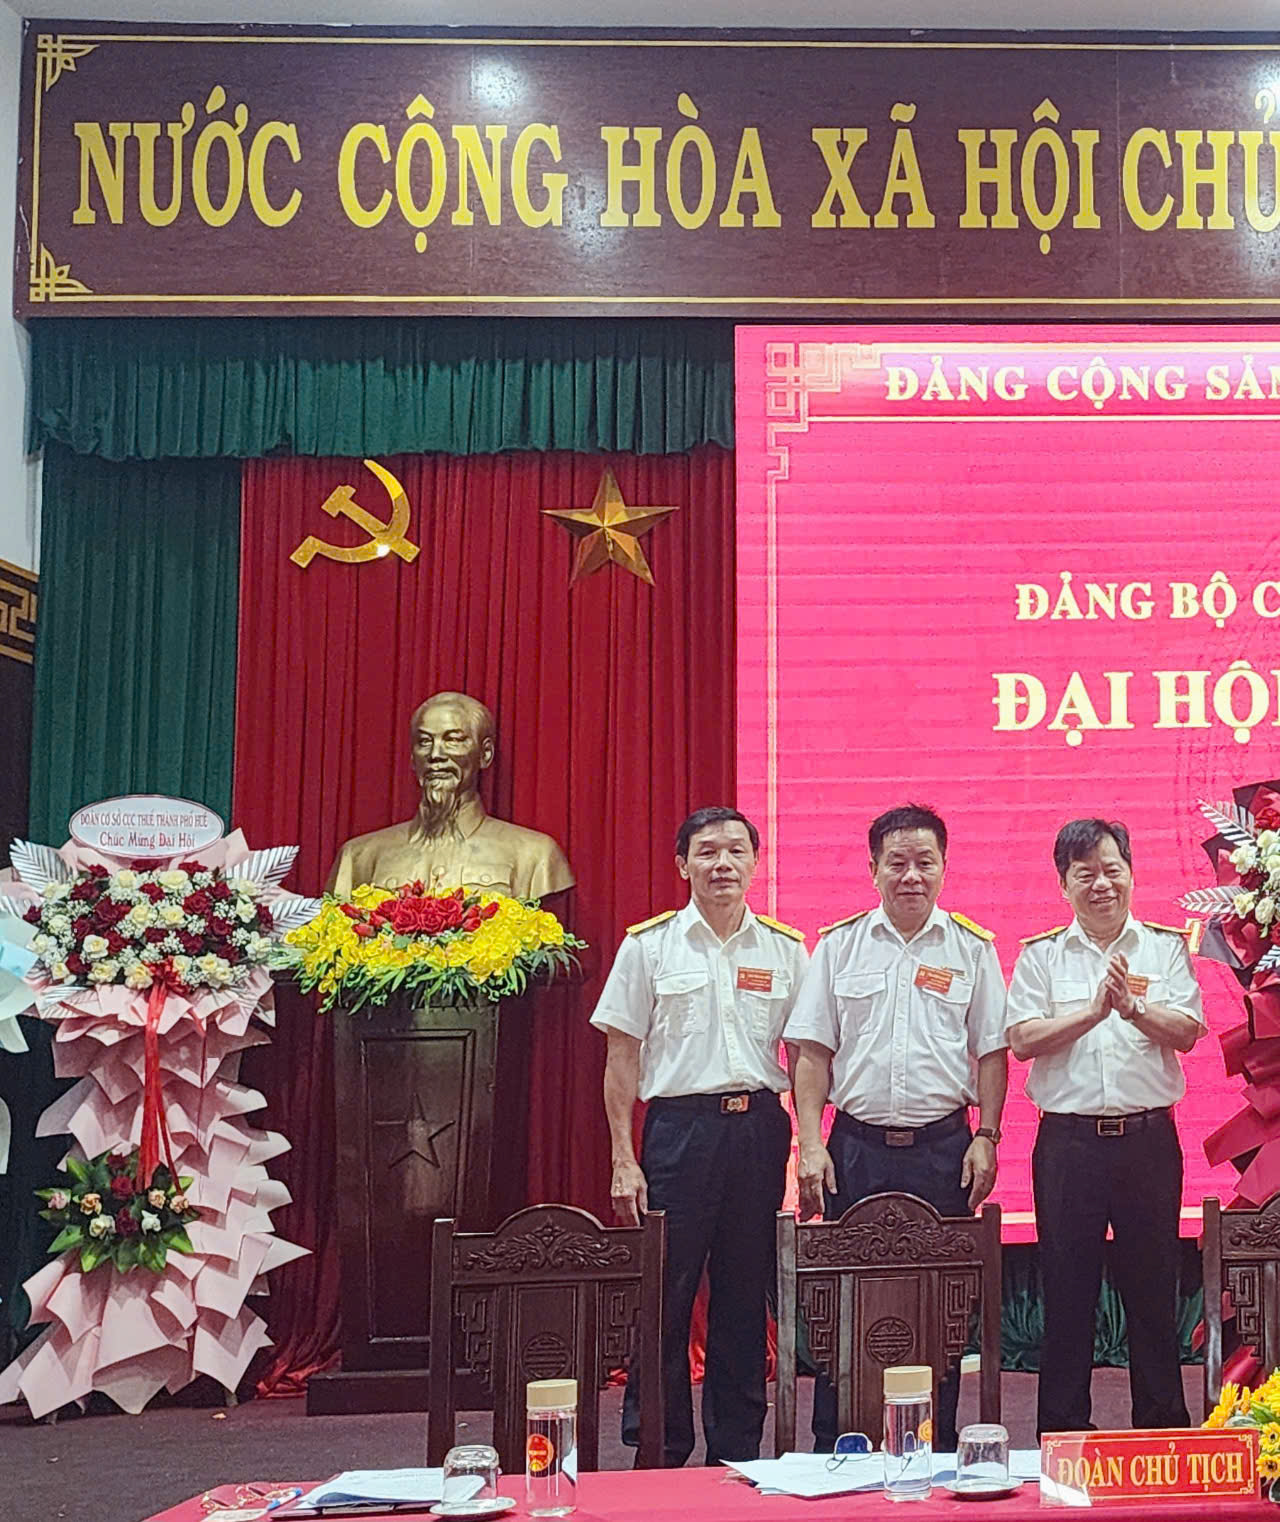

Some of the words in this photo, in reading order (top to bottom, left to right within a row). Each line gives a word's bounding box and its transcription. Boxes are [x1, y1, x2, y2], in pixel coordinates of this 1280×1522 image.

[72, 84, 302, 226] NƯỚC
[337, 93, 569, 254] CỘNG
[600, 92, 782, 230] HÒA
[812, 102, 935, 229] XÃ
[959, 98, 1101, 254] HỘI
[884, 355, 1028, 402] ĐẢNG
[1046, 357, 1188, 410] CỘNG
[1015, 571, 1154, 620] ĐẢNG
[1169, 572, 1238, 628] BỘ
[992, 671, 1134, 747] ĐẠI
[100, 832, 124, 847] Chúc
[1058, 1448, 1124, 1488] ĐOÀN
[1129, 1442, 1180, 1485] CHỦ
[1187, 1452, 1244, 1491] TỊCH
